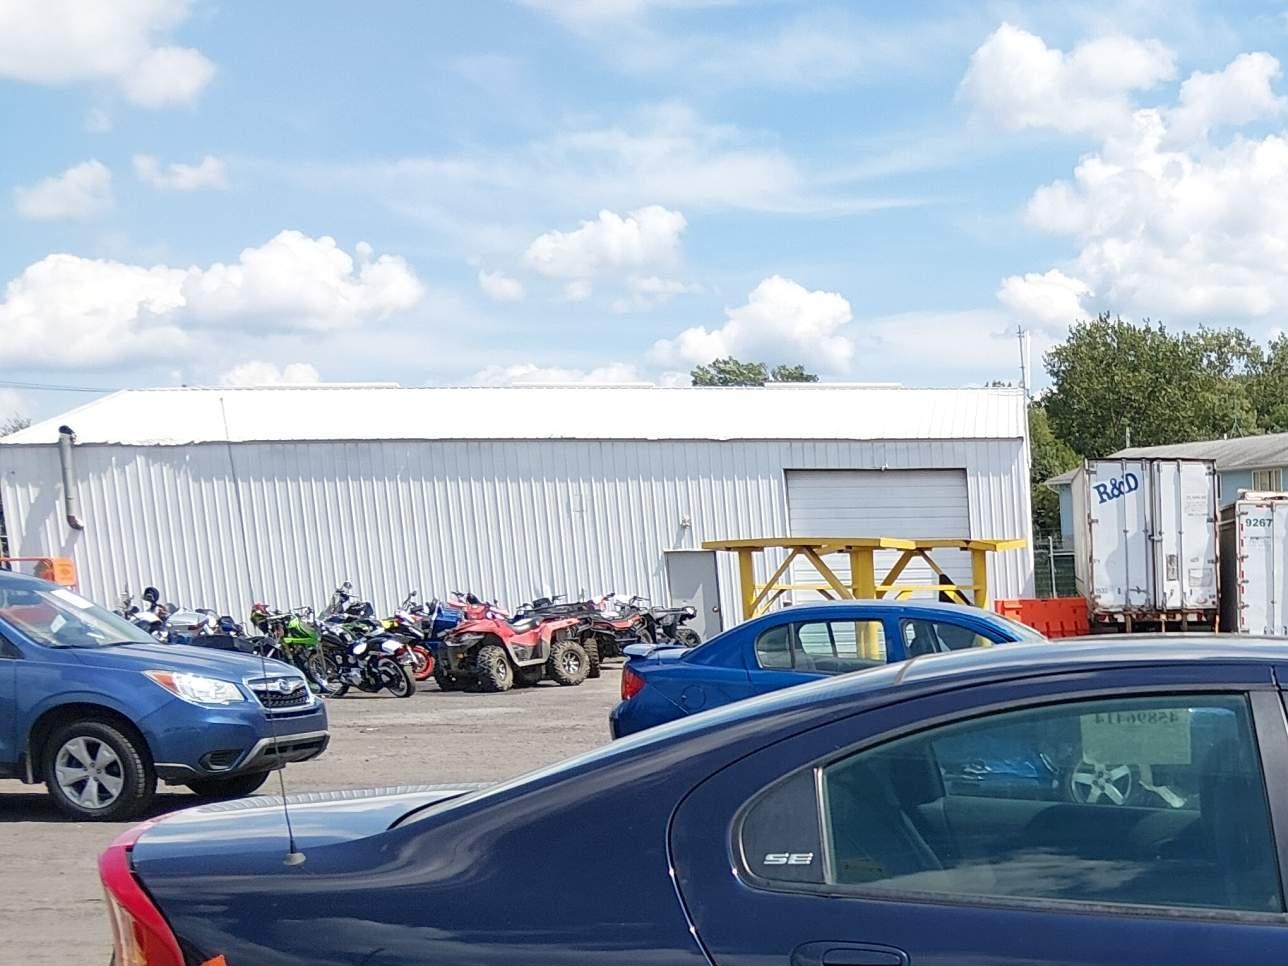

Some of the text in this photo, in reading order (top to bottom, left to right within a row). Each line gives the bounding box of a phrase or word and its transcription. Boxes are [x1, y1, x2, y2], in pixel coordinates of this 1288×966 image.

[1093, 473, 1139, 504] R&D
[1245, 518, 1273, 528] 9267
[763, 852, 814, 865] SE
